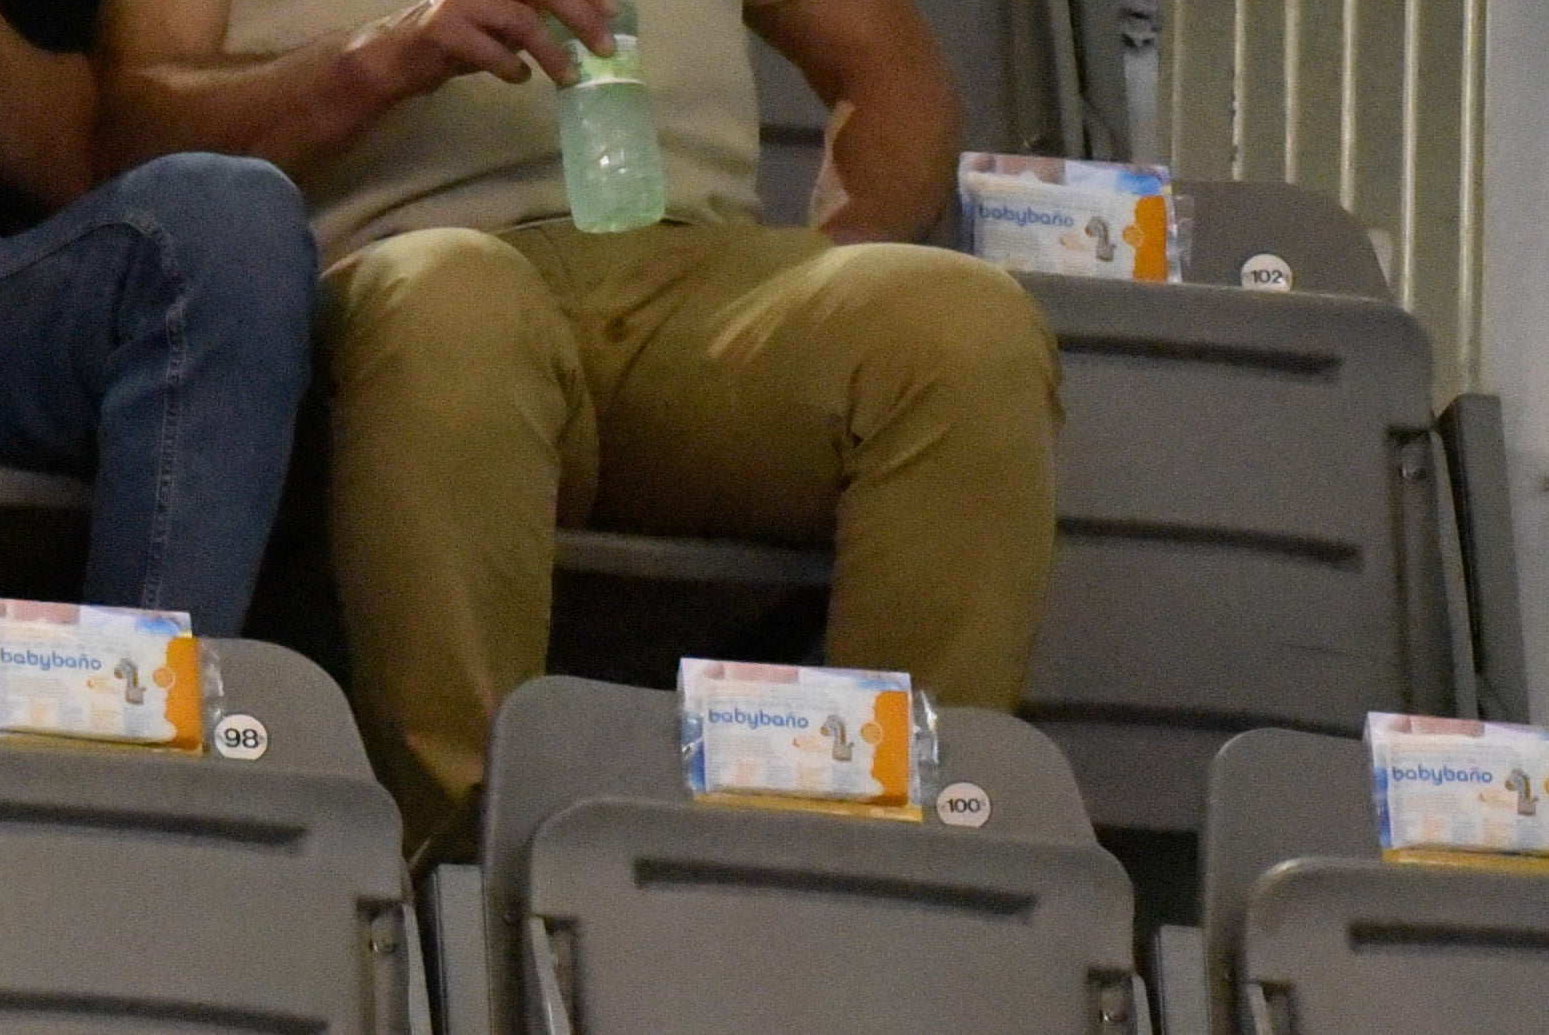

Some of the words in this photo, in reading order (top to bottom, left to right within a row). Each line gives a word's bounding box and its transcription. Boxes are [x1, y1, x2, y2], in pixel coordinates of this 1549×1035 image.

[978, 203, 1074, 228] babybaño
[1250, 269, 1286, 285] 102
[0, 647, 102, 671] babybaño
[708, 707, 809, 730] babybaño
[223, 728, 260, 749] 98
[1392, 764, 1493, 786] babybaño
[946, 797, 981, 814] 100
